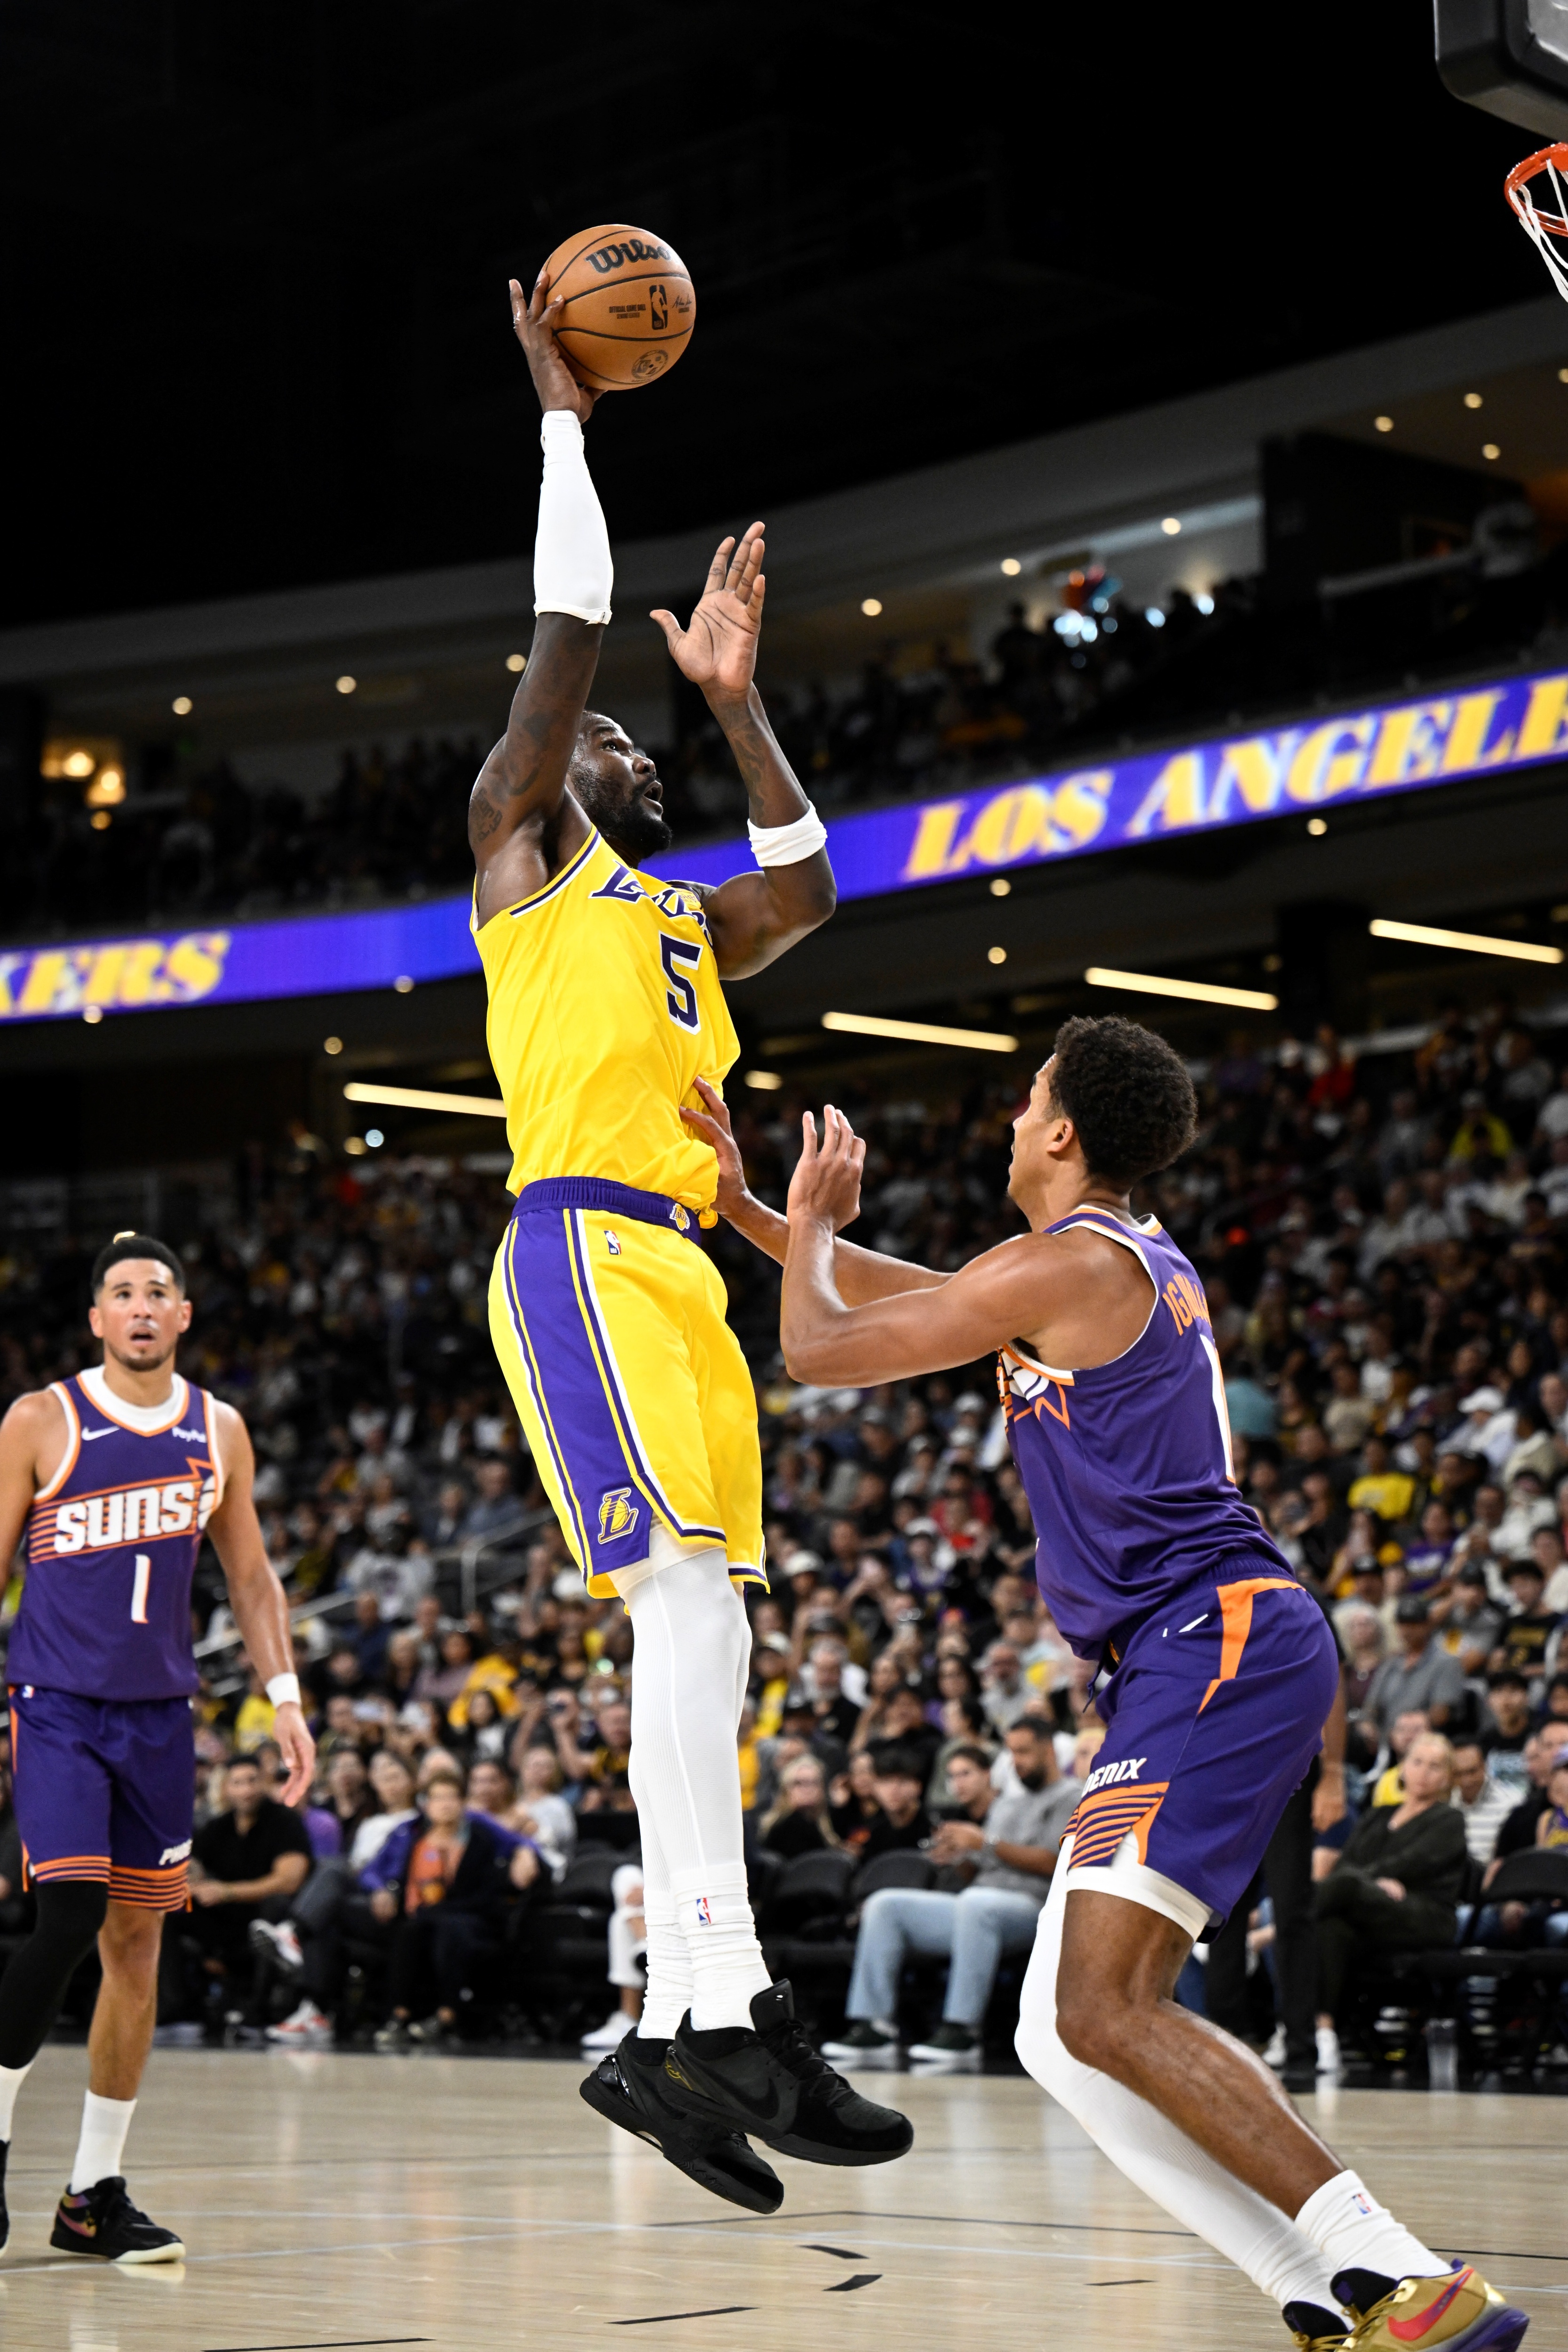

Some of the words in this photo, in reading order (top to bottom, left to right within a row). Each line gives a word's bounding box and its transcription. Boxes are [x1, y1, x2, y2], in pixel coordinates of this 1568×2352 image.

[584, 239, 672, 274] Wilso
[903, 769, 1115, 881] LOS
[659, 930, 704, 1035] 5
[54, 1482, 195, 1553] SUNS
[131, 1554, 151, 1623] 1
